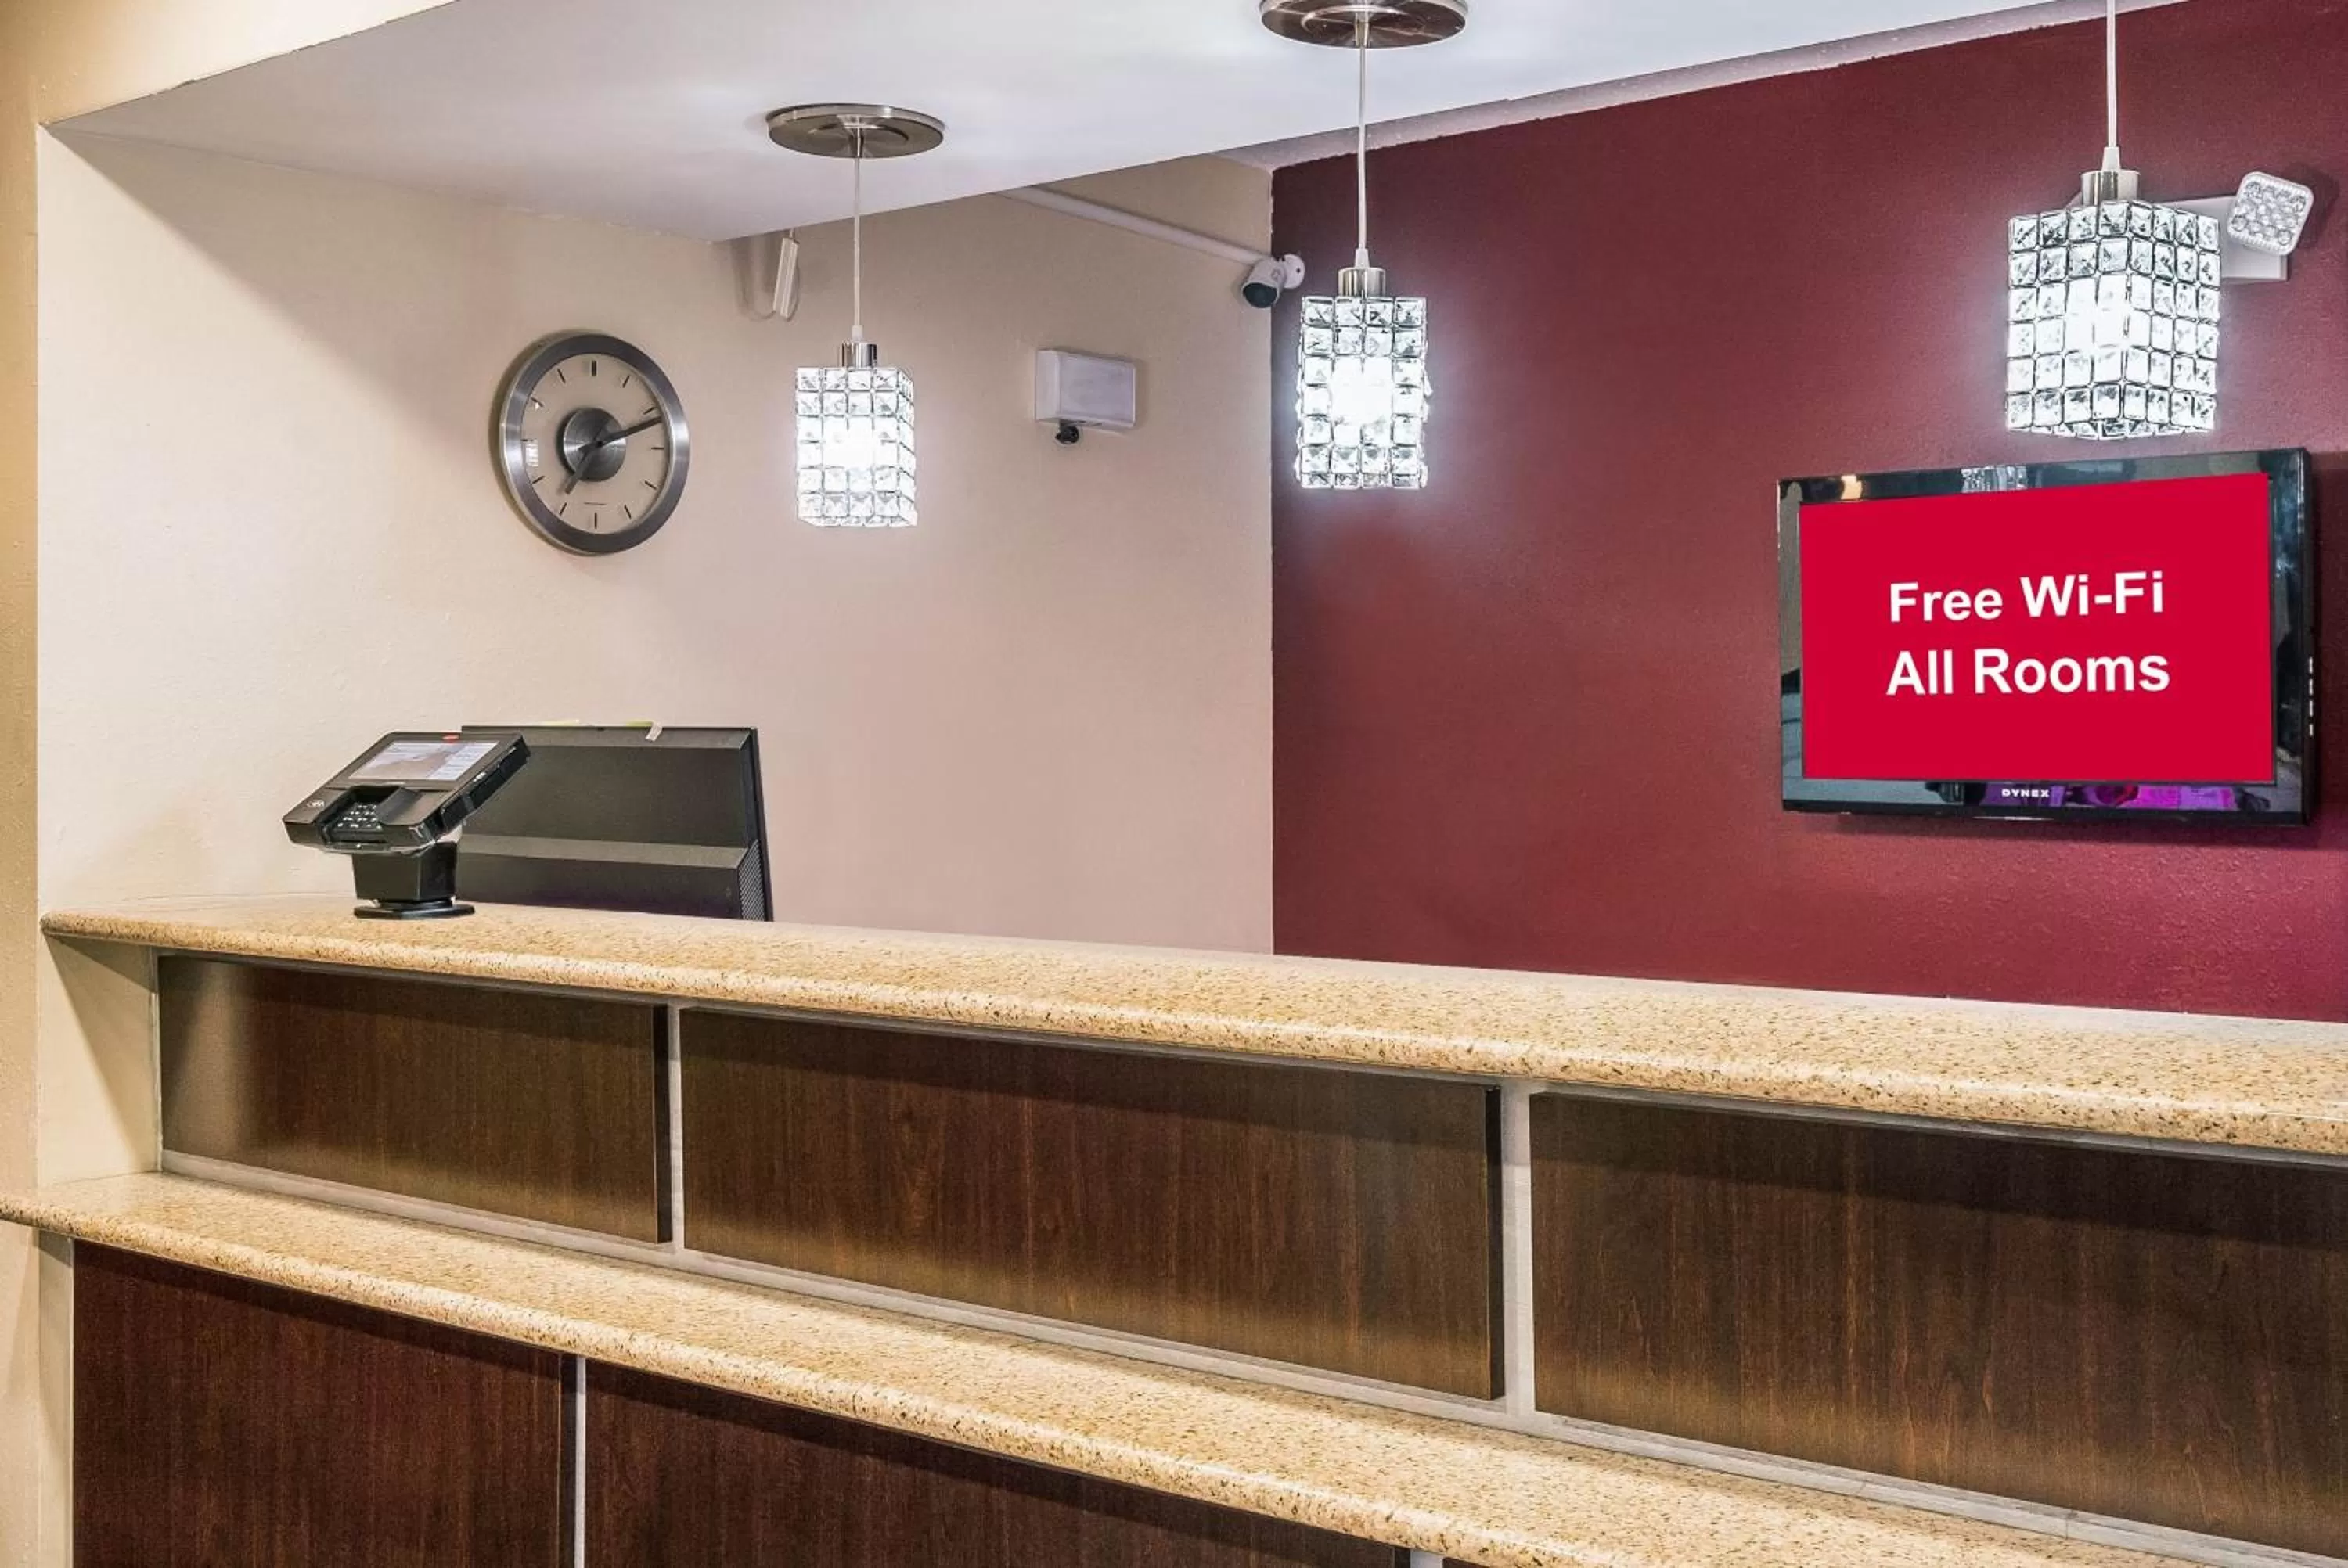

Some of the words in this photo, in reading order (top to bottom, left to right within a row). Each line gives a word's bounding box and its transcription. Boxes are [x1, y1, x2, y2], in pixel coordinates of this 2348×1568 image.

[1889, 582, 2003, 623] Free
[2020, 570, 2164, 617] Wi-Fi
[1886, 649, 1954, 696] All
[1974, 648, 2170, 695] Rooms
[2001, 788, 2050, 797] DYNEX
